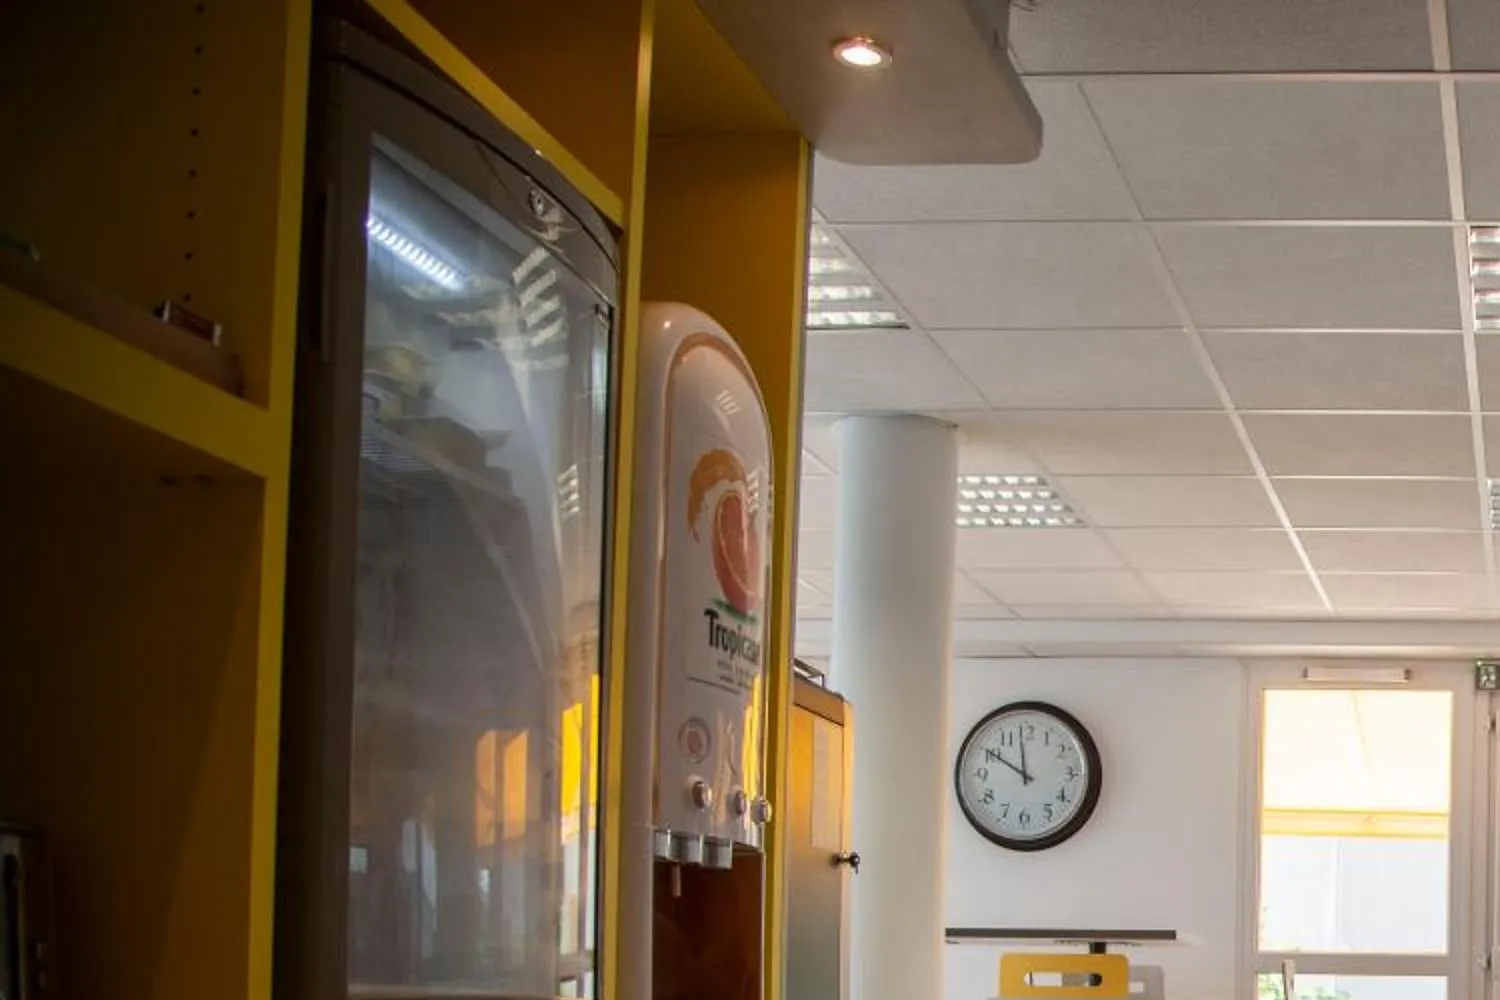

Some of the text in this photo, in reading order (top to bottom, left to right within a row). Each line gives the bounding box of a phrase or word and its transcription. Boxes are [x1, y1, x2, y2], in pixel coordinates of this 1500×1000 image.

[1001, 732, 1012, 746] 11
[977, 768, 988, 781] 9
[983, 788, 994, 804] 8
[1056, 787, 1066, 802] 4
[1001, 803, 1010, 818] 7
[1019, 807, 1030, 824] 6
[1043, 803, 1053, 821] 5
